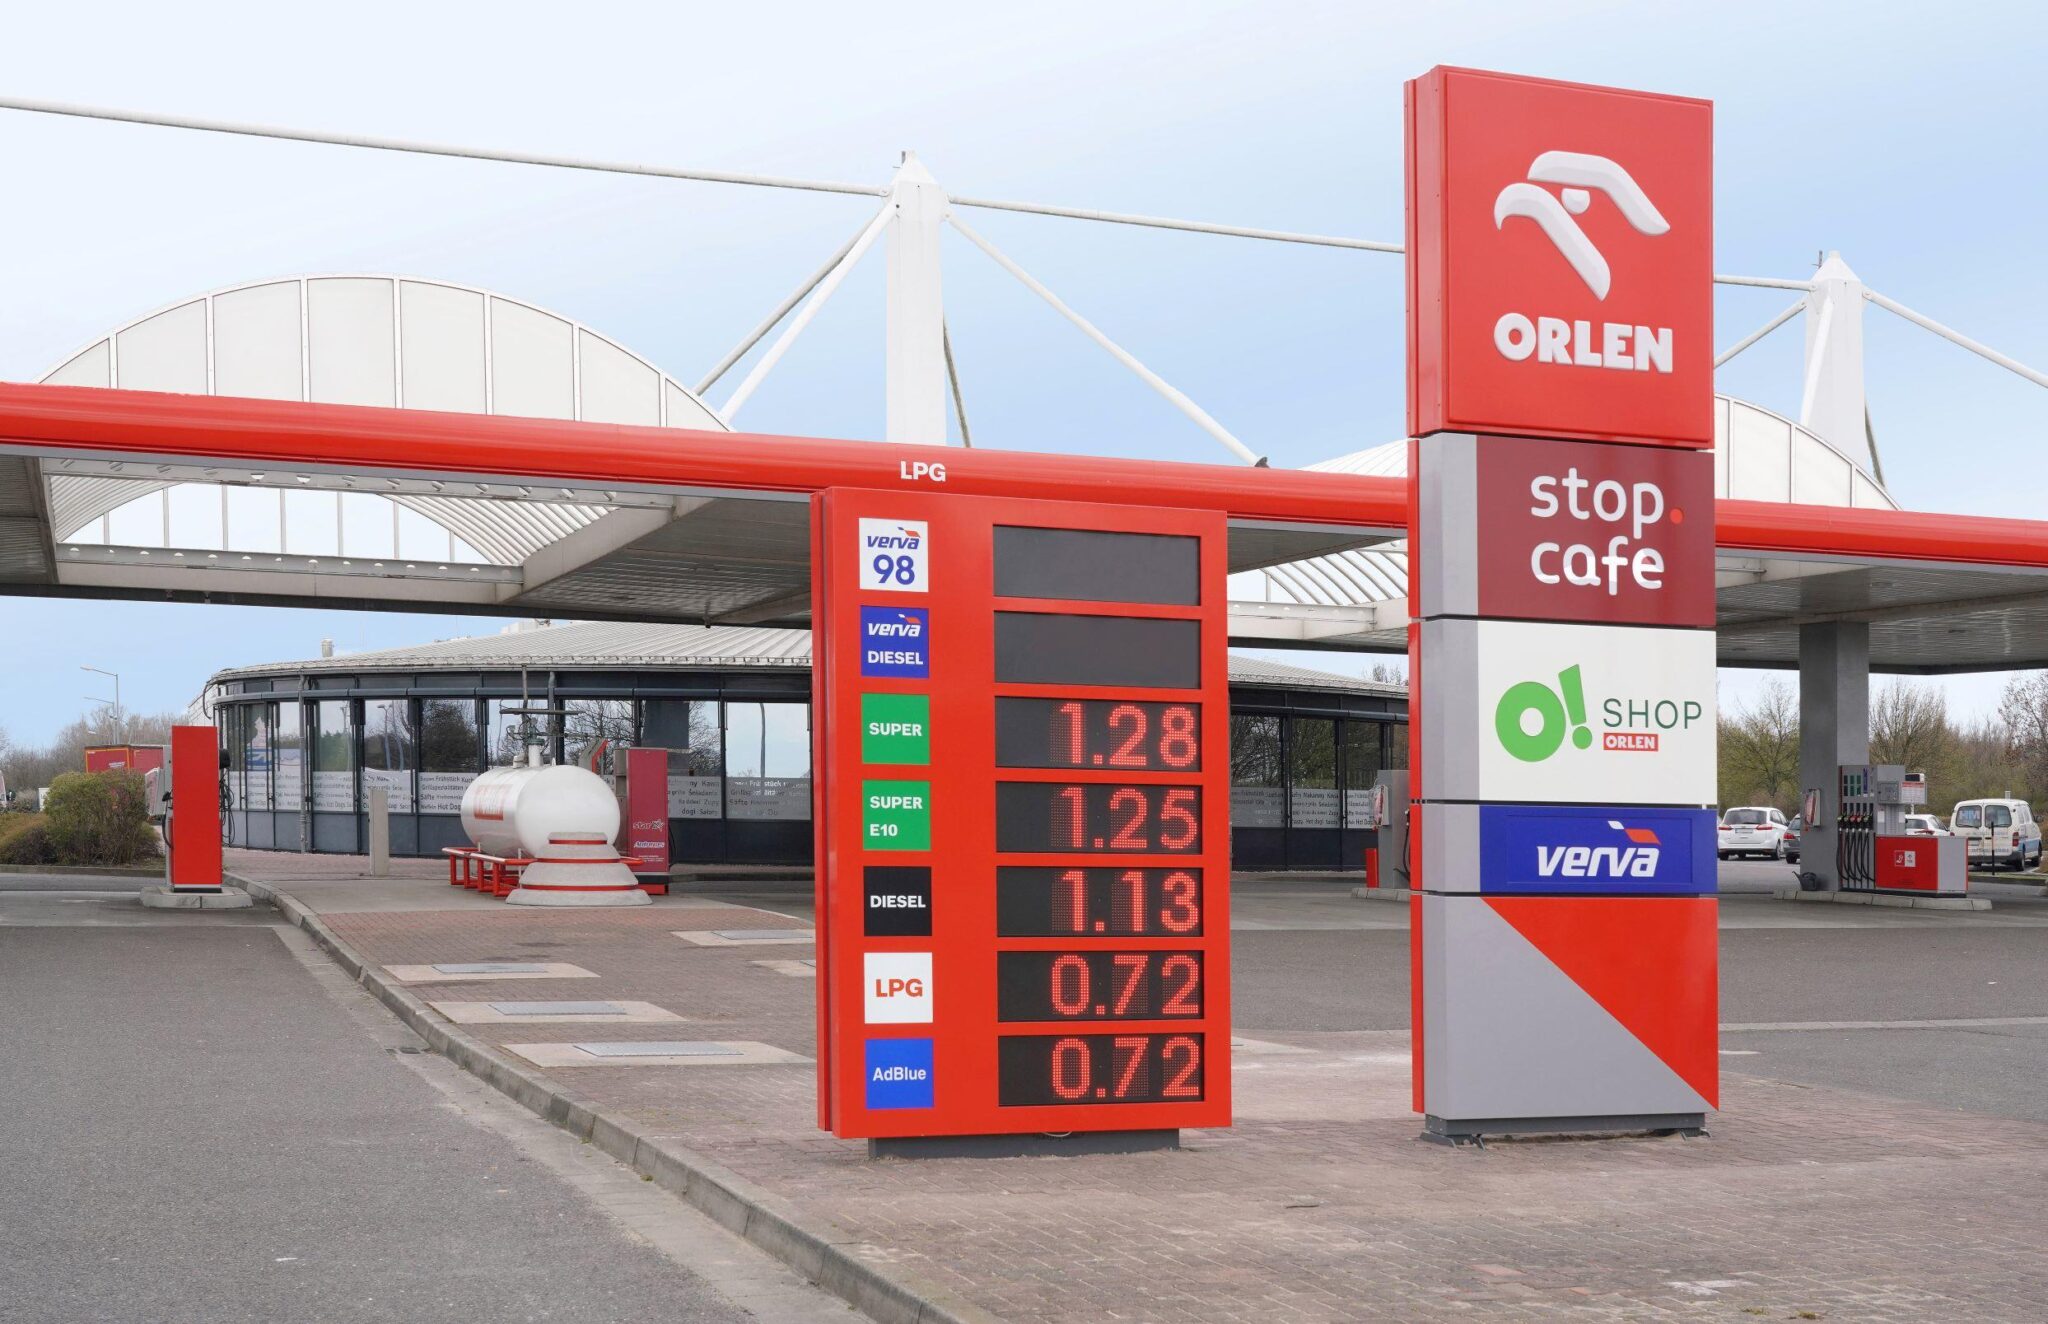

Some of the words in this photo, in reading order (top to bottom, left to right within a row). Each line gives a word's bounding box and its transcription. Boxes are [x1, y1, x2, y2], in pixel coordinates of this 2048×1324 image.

[1494, 312, 1673, 373] ORLEN
[900, 461, 946, 482] LPG
[867, 536, 920, 550] verva
[873, 554, 915, 585] 98
[1531, 535, 1665, 596] cafe
[868, 623, 921, 638] verva
[867, 651, 924, 665] DIESEL
[1603, 698, 1702, 729] SHOP
[869, 722, 923, 737] SUPER
[1060, 703, 1198, 767] 1.28
[1605, 735, 1655, 749] ORLEN
[870, 796, 923, 810] SUPER
[1060, 787, 1198, 849] 1.25
[870, 824, 898, 837] E10
[1537, 845, 1660, 877] verva
[870, 895, 926, 908] DIESEL
[1062, 871, 1199, 932] 1.13
[876, 978, 923, 997] LPG
[1051, 955, 1199, 1015] 0.72
[873, 1067, 926, 1081] AdBlue
[1052, 1036, 1200, 1098] 0.72
